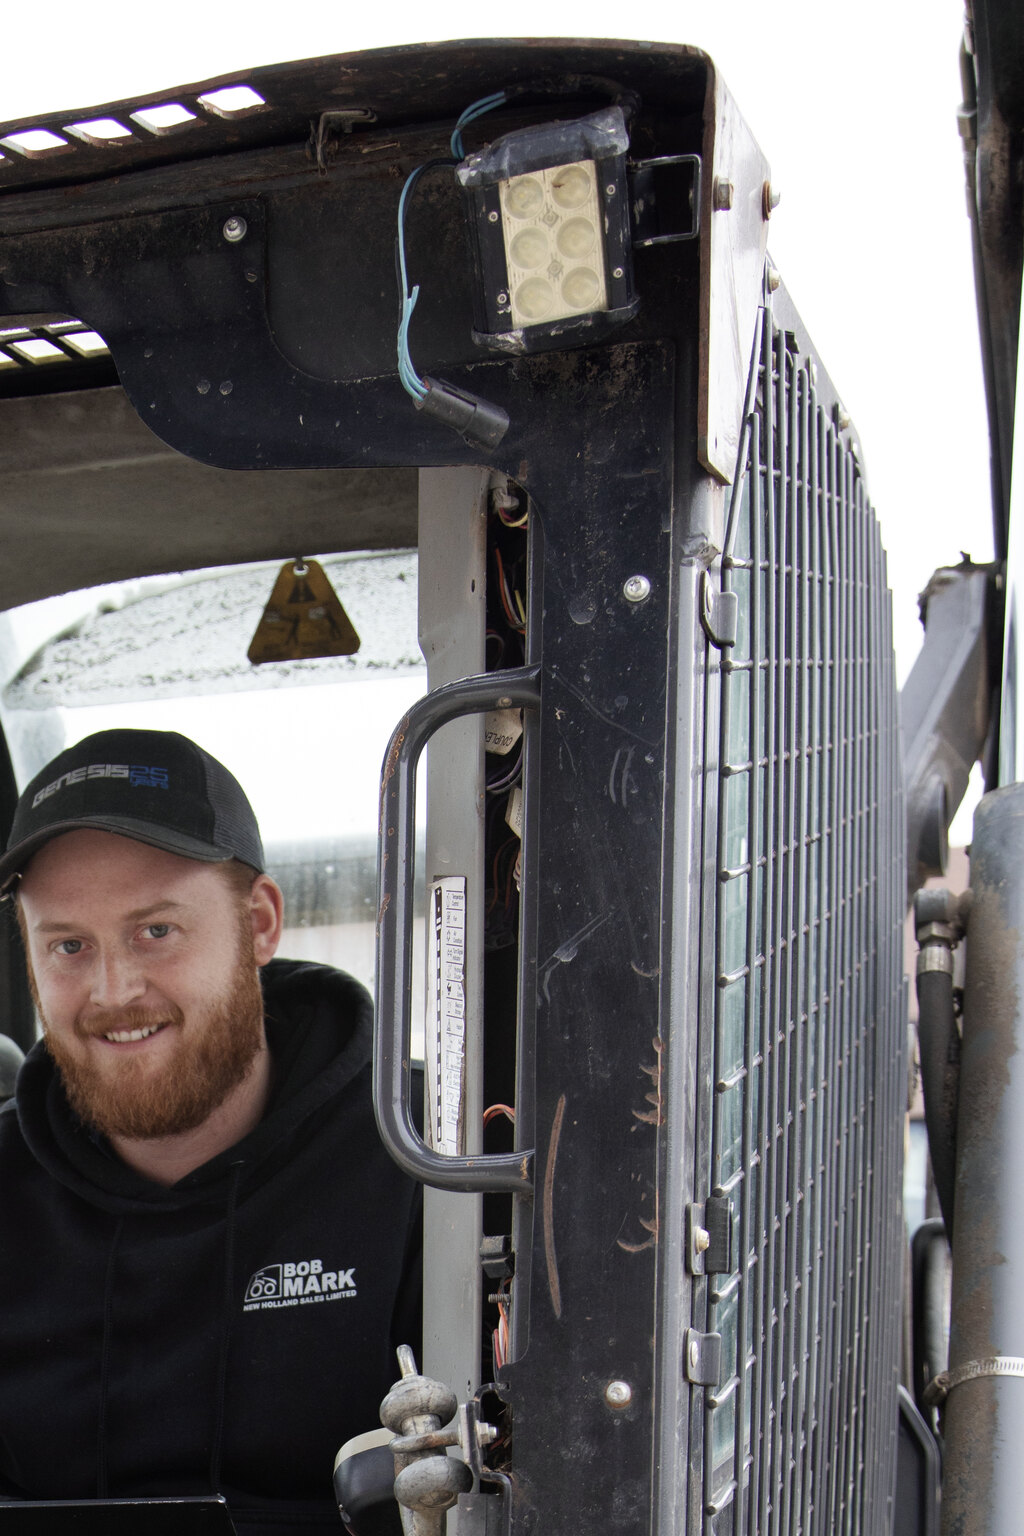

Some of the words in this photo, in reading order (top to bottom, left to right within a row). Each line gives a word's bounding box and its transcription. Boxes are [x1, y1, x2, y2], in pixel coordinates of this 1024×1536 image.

[32, 764, 129, 809] GENESIS
[130, 765, 169, 782] 25
[283, 1259, 323, 1278] BOB
[283, 1268, 356, 1297] MARK
[243, 1303, 260, 1312] NEW
[261, 1299, 298, 1310] HOLLAND
[300, 1295, 324, 1305] SALES
[326, 1290, 357, 1301] LIMITED
